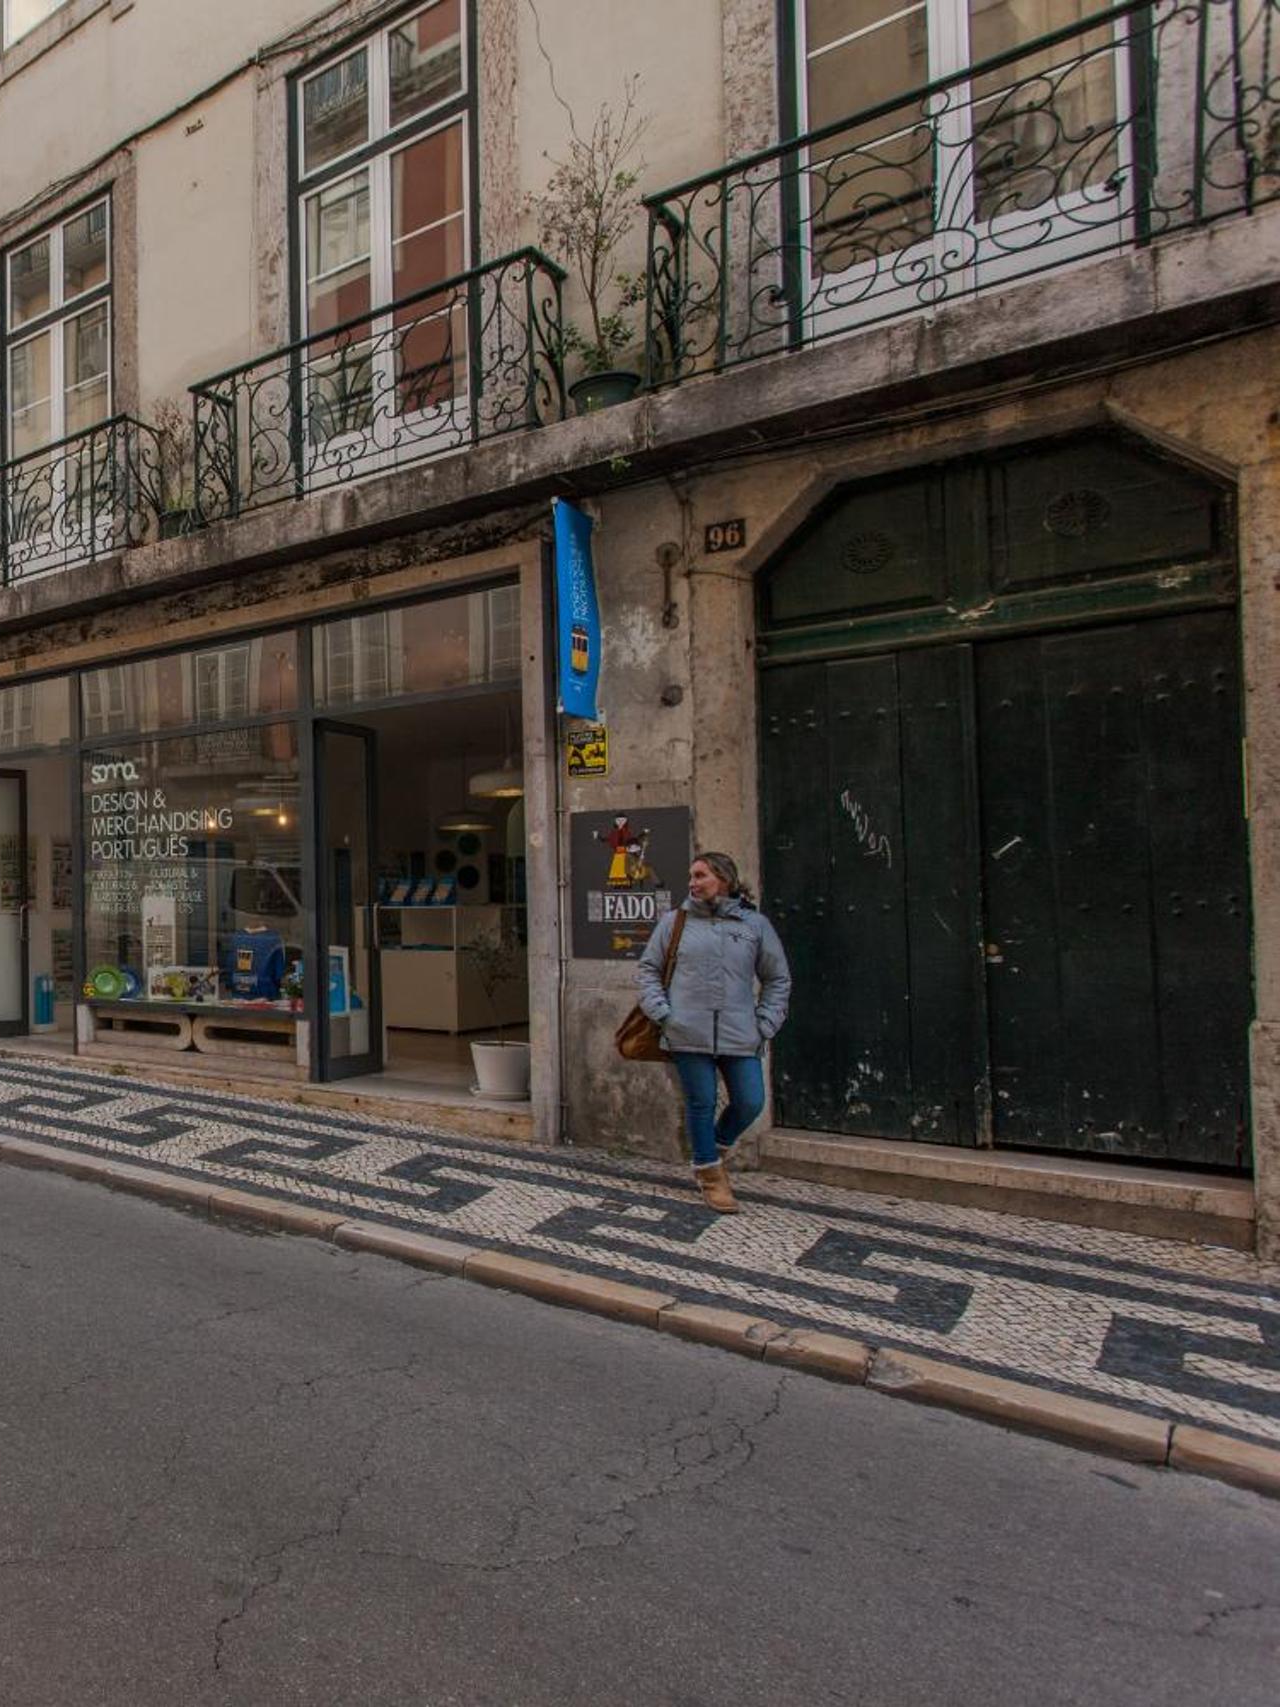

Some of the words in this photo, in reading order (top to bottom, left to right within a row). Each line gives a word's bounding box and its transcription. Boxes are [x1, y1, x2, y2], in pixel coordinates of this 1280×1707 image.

[710, 522, 741, 551] 96
[91, 789, 148, 814] DESIGN
[152, 788, 167, 809] &
[91, 808, 233, 836] MERCHANDISING
[91, 833, 189, 860] PORTUGUÊS
[603, 894, 656, 921] FADO
